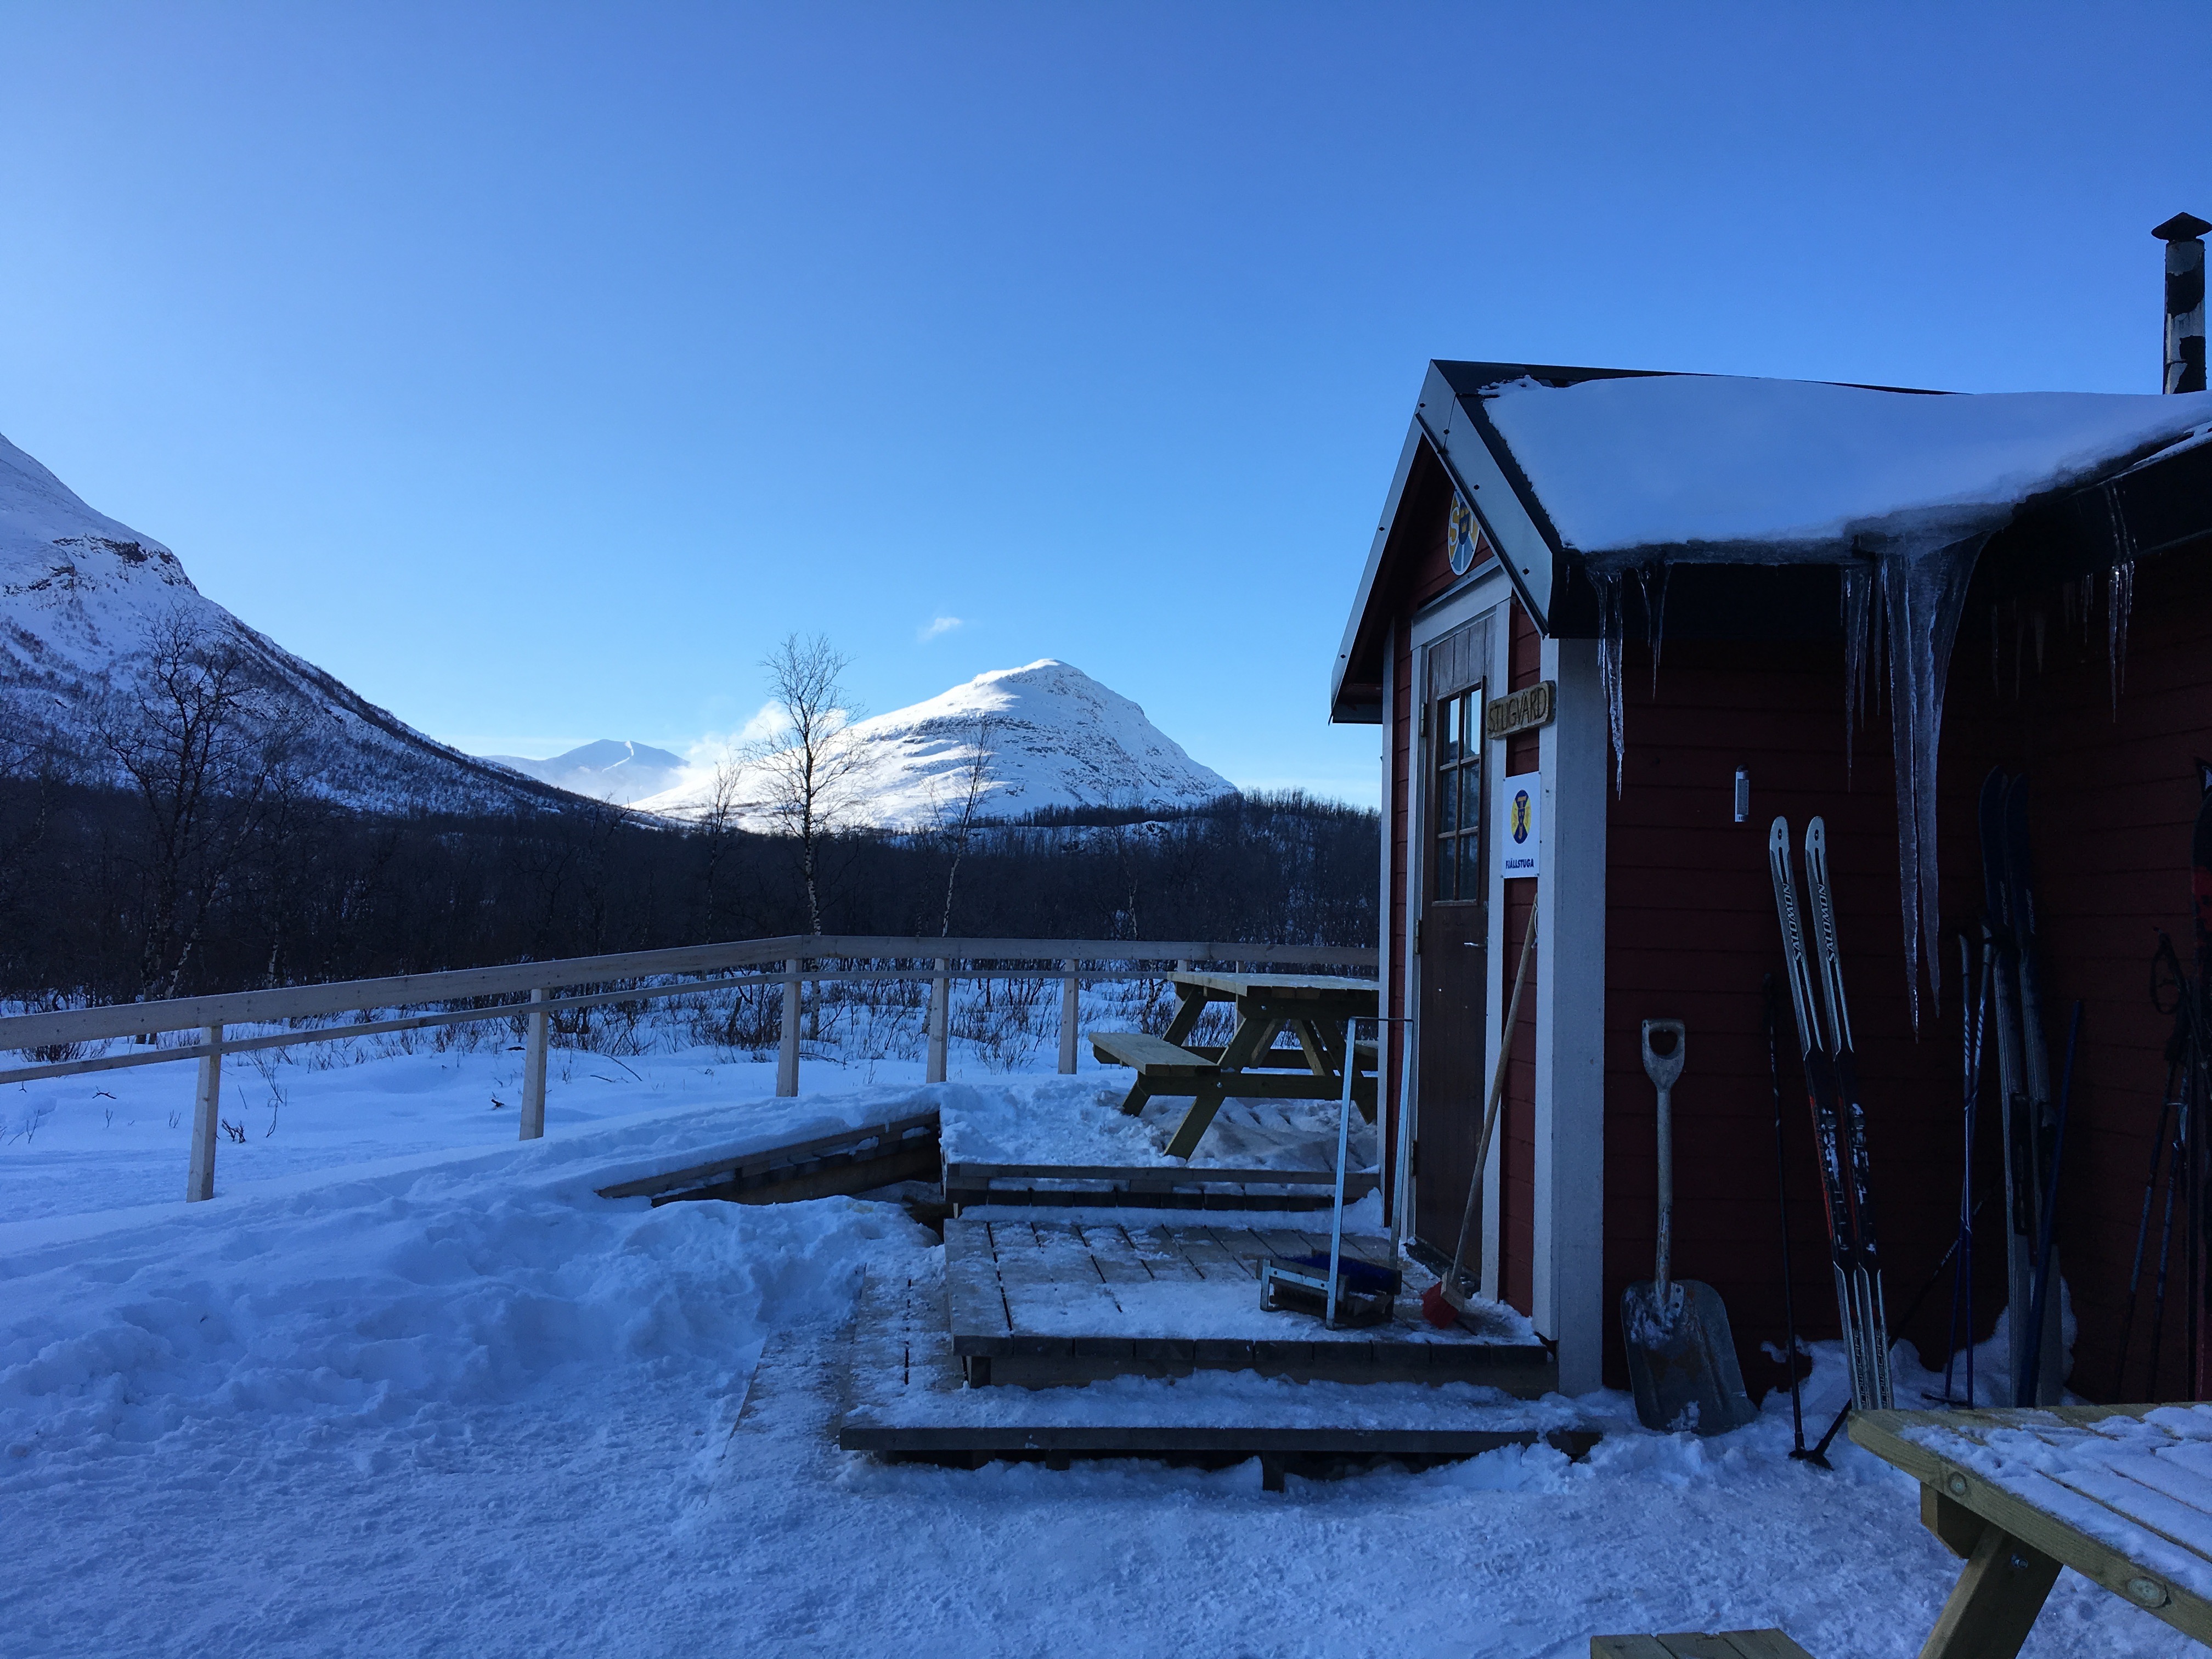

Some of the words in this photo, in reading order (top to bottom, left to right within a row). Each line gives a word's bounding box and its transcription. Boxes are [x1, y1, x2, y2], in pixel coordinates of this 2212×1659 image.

[1488, 687, 1547, 733] STUGVÄRD
[1782, 883, 1802, 961] SALOMON
[1818, 883, 1836, 961] SALOMON
[2026, 889, 2036, 935] FISCHER
